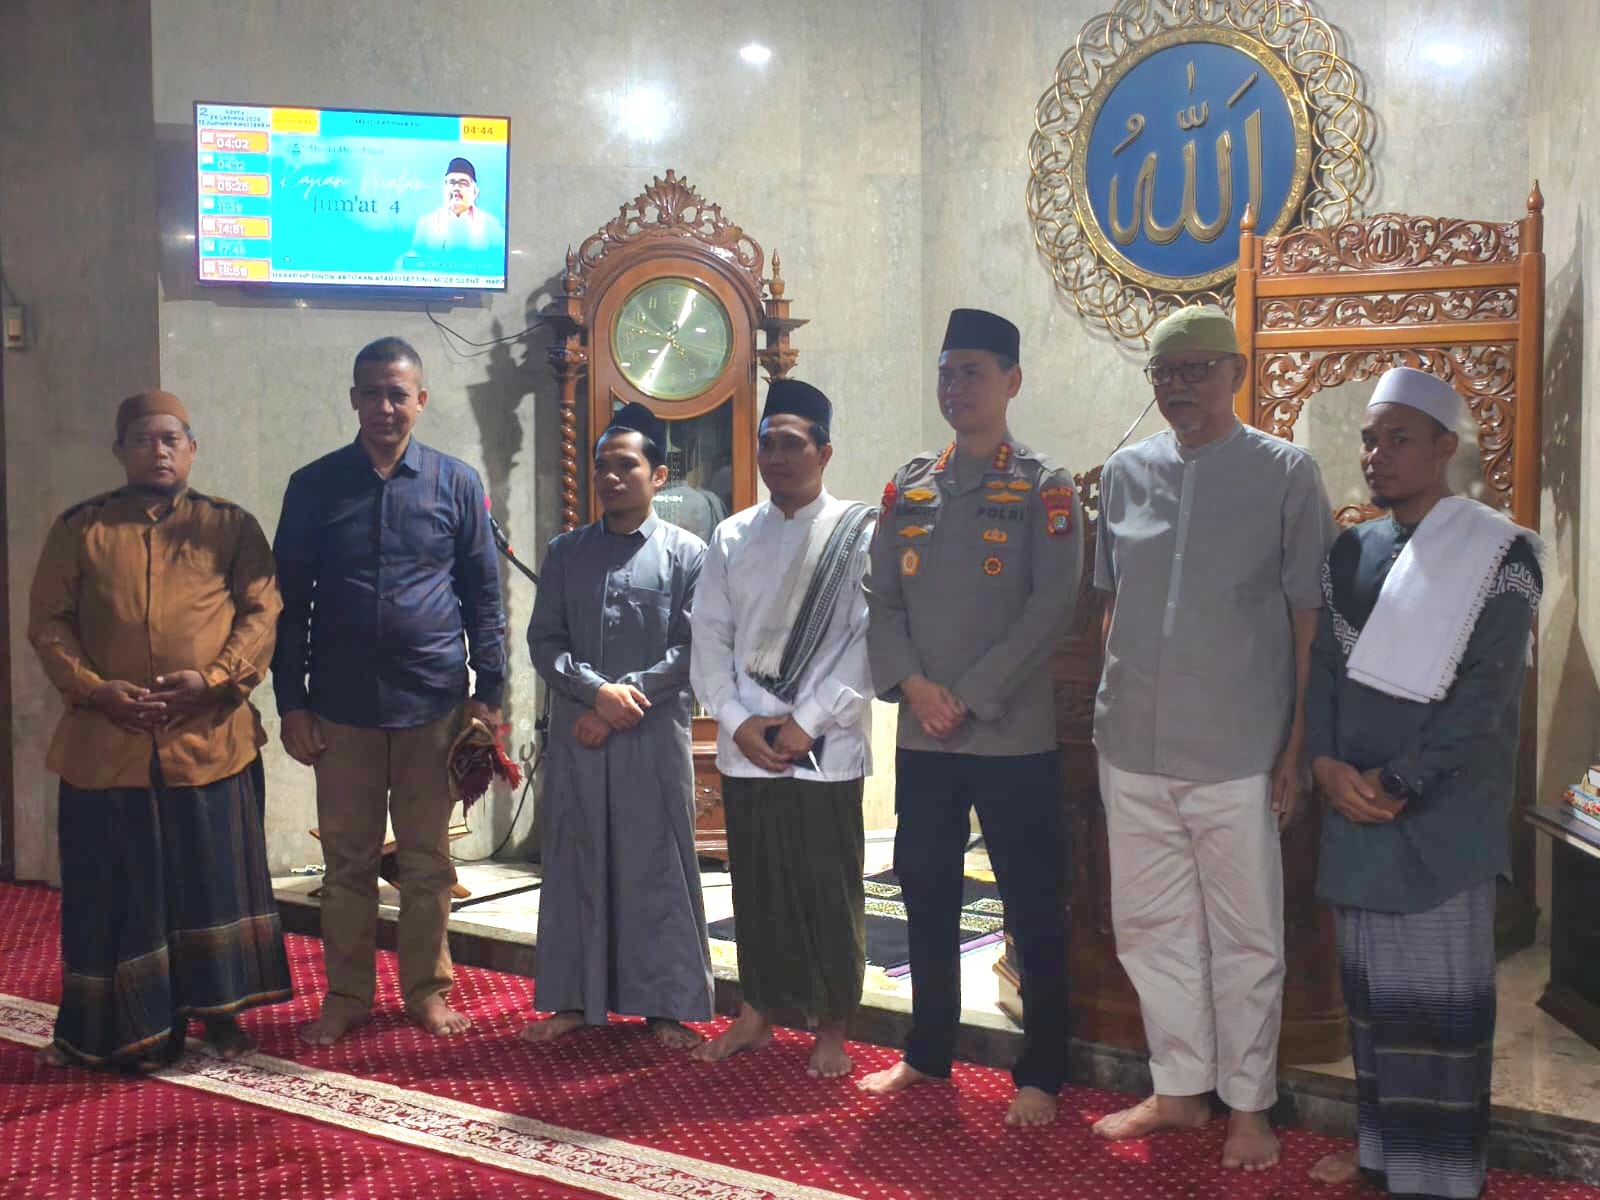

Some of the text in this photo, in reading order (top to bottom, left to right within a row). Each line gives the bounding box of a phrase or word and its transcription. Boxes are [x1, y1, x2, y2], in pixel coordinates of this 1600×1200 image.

[463, 125, 493, 135] 04:44
[216, 137, 249, 149] 04:02
[312, 195, 400, 214] Jum'at 4
[976, 504, 1024, 521] POLRI
